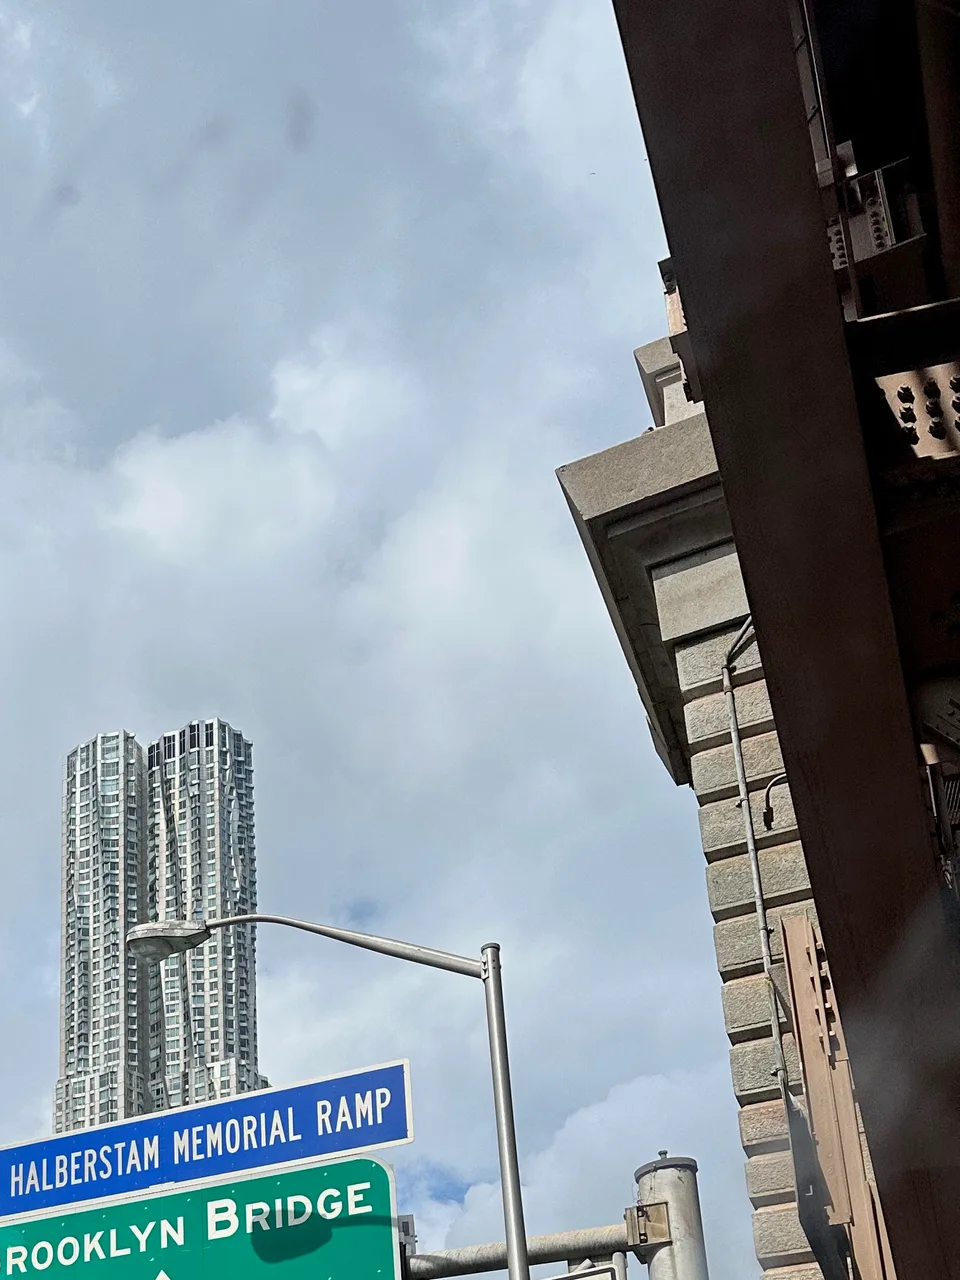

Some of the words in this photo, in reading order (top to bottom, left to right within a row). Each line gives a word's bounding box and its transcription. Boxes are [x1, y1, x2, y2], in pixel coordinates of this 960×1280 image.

[10, 1135, 159, 1197] HALBERSTAM
[173, 1107, 301, 1165] MEMORIAL
[316, 1087, 392, 1133] RAMP
[207, 1182, 373, 1241] BRIDGE
